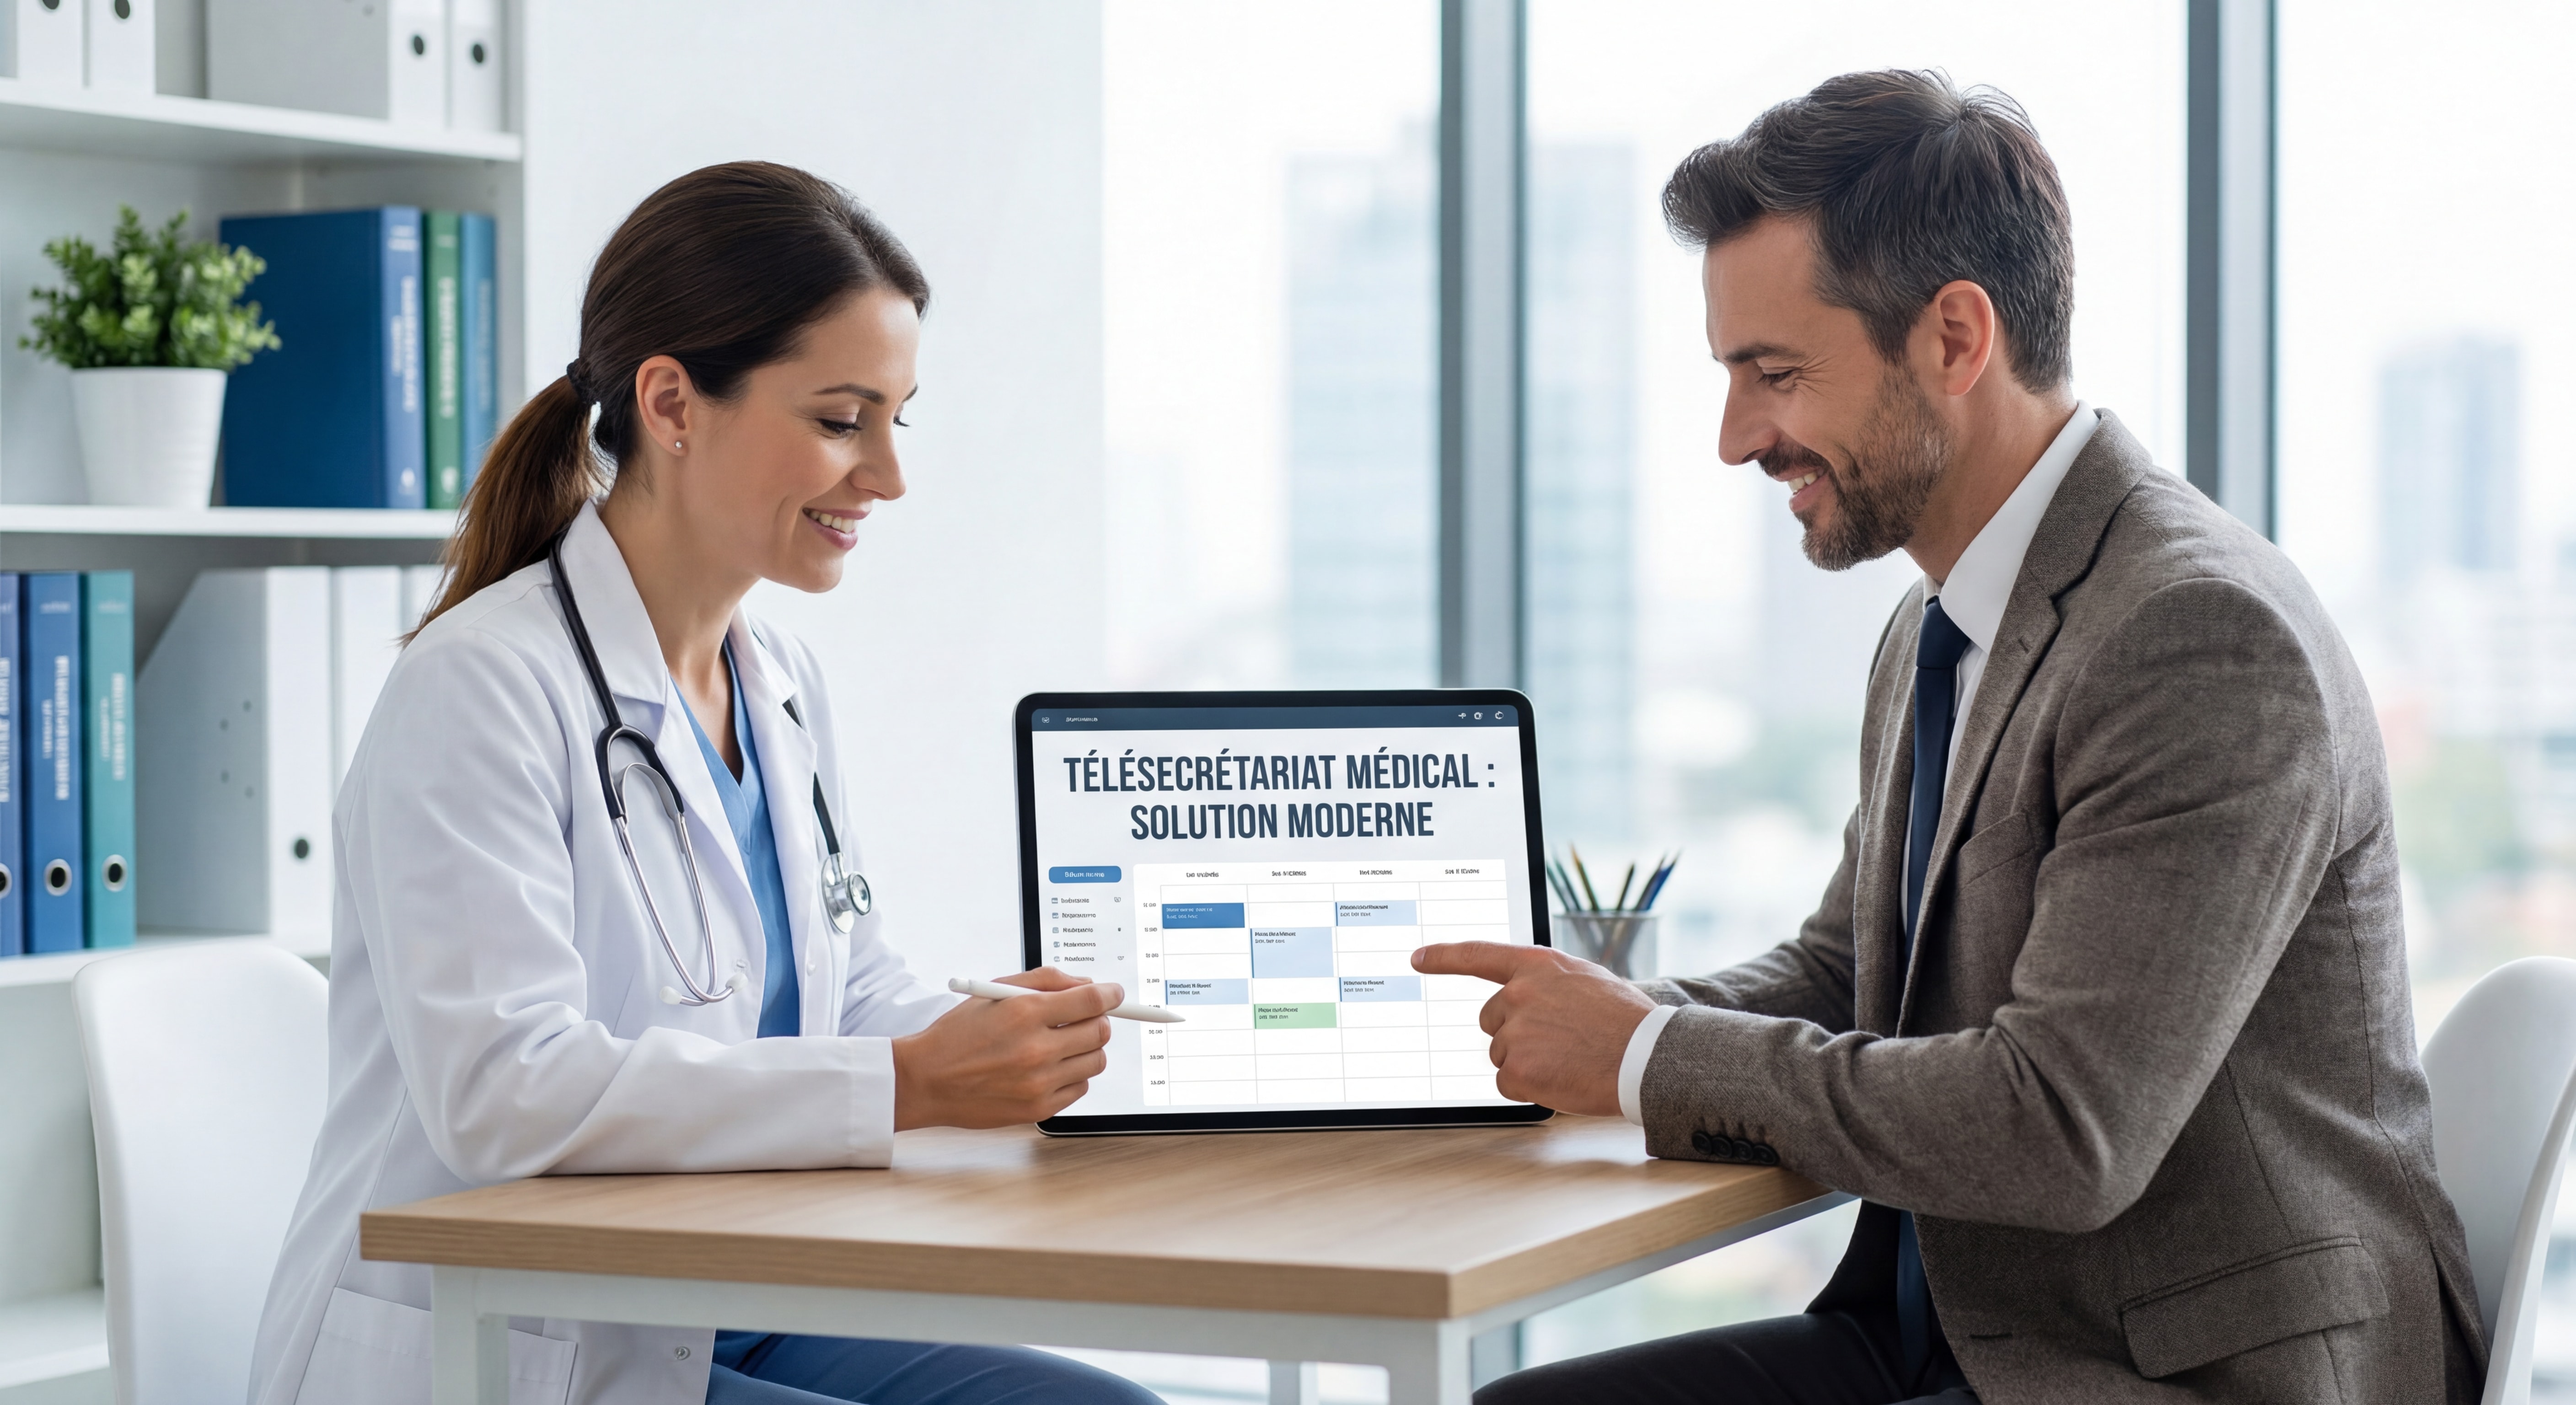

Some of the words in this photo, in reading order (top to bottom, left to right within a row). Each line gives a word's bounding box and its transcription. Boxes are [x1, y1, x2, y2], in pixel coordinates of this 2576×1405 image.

[1063, 746, 1336, 793] TÉLÉSECRÉTARIAT
[1346, 746, 1478, 789] MÉDICAL
[1488, 763, 1495, 788] :
[1131, 804, 1277, 840] SOLUTION
[1288, 802, 1434, 838] MODERNE
